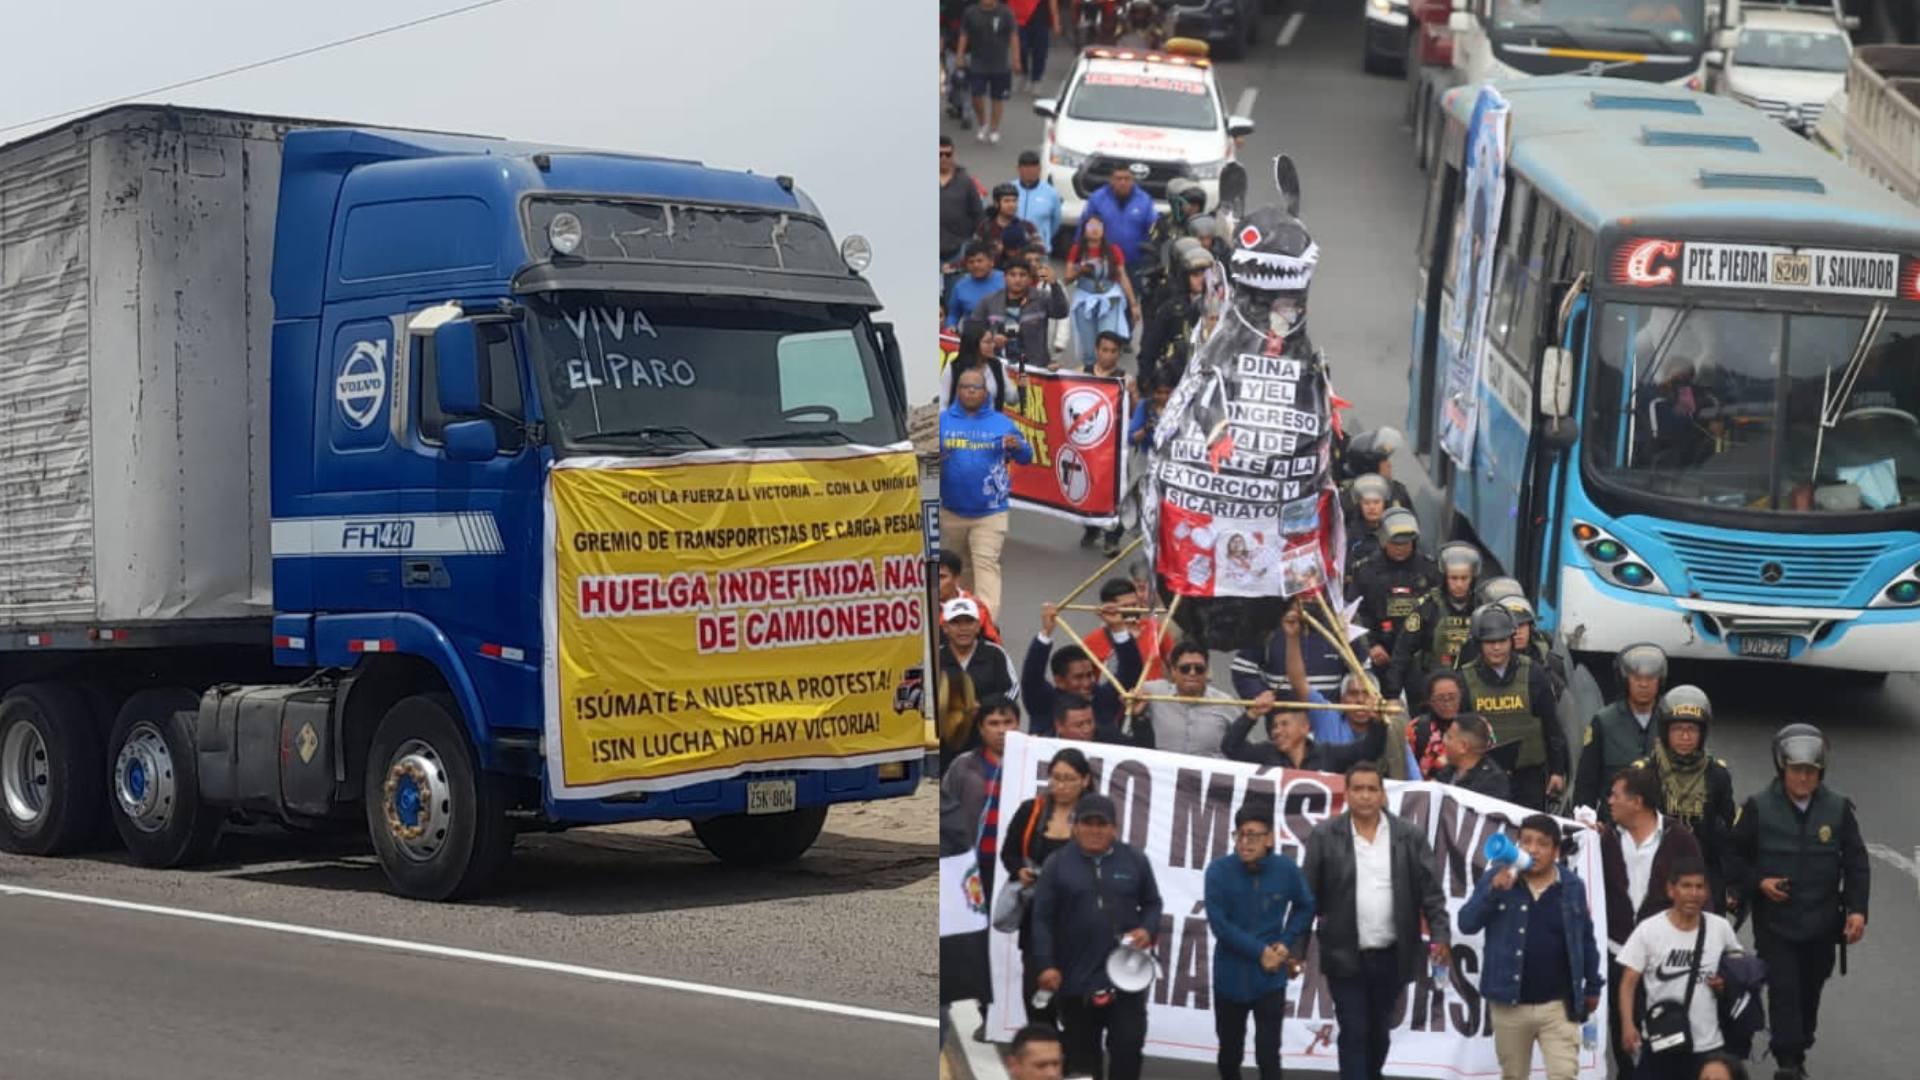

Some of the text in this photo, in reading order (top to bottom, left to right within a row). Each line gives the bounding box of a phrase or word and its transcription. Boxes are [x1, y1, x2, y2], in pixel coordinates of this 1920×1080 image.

[1688, 248, 1767, 284] PTE. PIEDRA
[1774, 261, 1808, 281] 8209
[1815, 255, 1894, 290] V. SALVADOR
[561, 307, 658, 340] VIVA
[567, 353, 696, 389] EL PARO
[1243, 357, 1295, 377] DINA
[339, 378, 382, 393] VOLVO
[1246, 383, 1292, 400] Y EL
[1227, 404, 1316, 431] NGRESO
[1263, 434, 1294, 453] DE
[1173, 442, 1313, 477] MUTE A LA
[662, 489, 680, 504] LA
[682, 488, 735, 503] FUERZA
[753, 484, 810, 501] VICTORIA
[826, 481, 850, 496] CON
[853, 479, 869, 494] LA
[1168, 490, 1279, 518] SICARIATO
[1285, 483, 1298, 498] Y
[574, 530, 642, 552] GREMIO
[648, 530, 670, 550] DE
[674, 524, 808, 550] TRANSPORTISTAS
[811, 521, 833, 542] DE
[834, 517, 881, 538] CARGA
[580, 574, 711, 614] HUELGA
[718, 562, 876, 605] INDEFINIDA
[699, 599, 921, 650] DE CAMIONEROS
[684, 689, 700, 711] A
[703, 680, 794, 707] NUESTRA
[797, 668, 892, 700] PROTESTA!
[1476, 696, 1524, 711] POLICIA
[643, 730, 717, 758] LUCHA
[723, 725, 754, 748] NO
[760, 719, 797, 745] HAY
[803, 712, 880, 741] VICTORIA!
[1665, 949, 1696, 967] NIK
